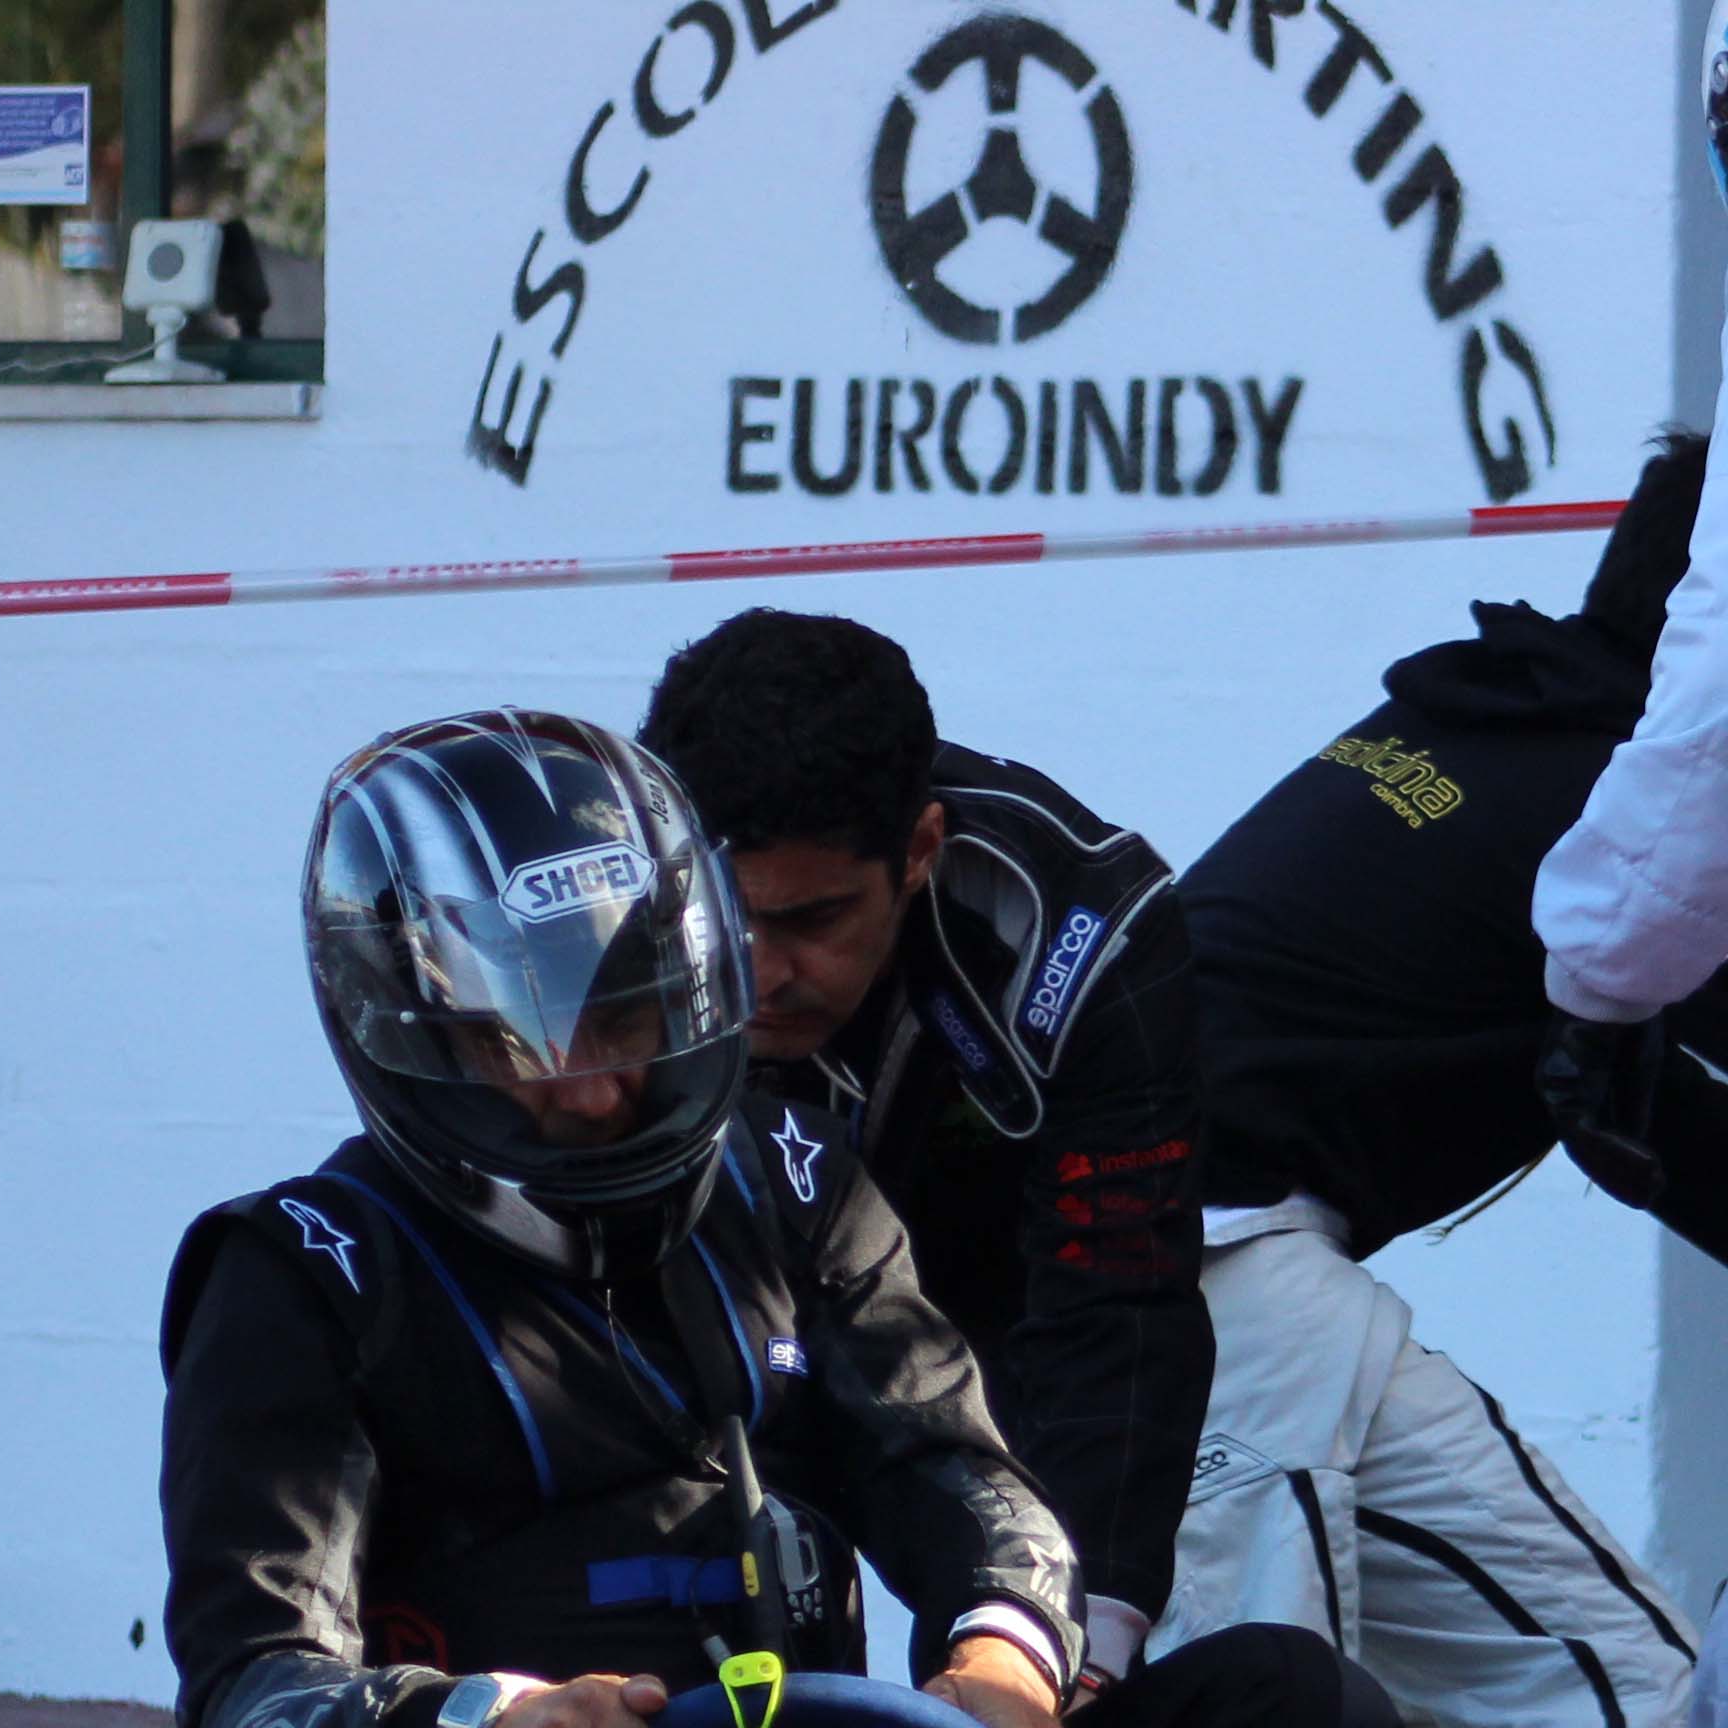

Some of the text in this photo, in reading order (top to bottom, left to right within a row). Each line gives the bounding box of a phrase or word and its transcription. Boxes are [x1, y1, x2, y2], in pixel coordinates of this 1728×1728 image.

[1177, 0, 1556, 501] RTING
[726, 375, 1305, 497] EUROINDY
[523, 852, 640, 910] SHOEI
[1027, 913, 1094, 1028] sparco
